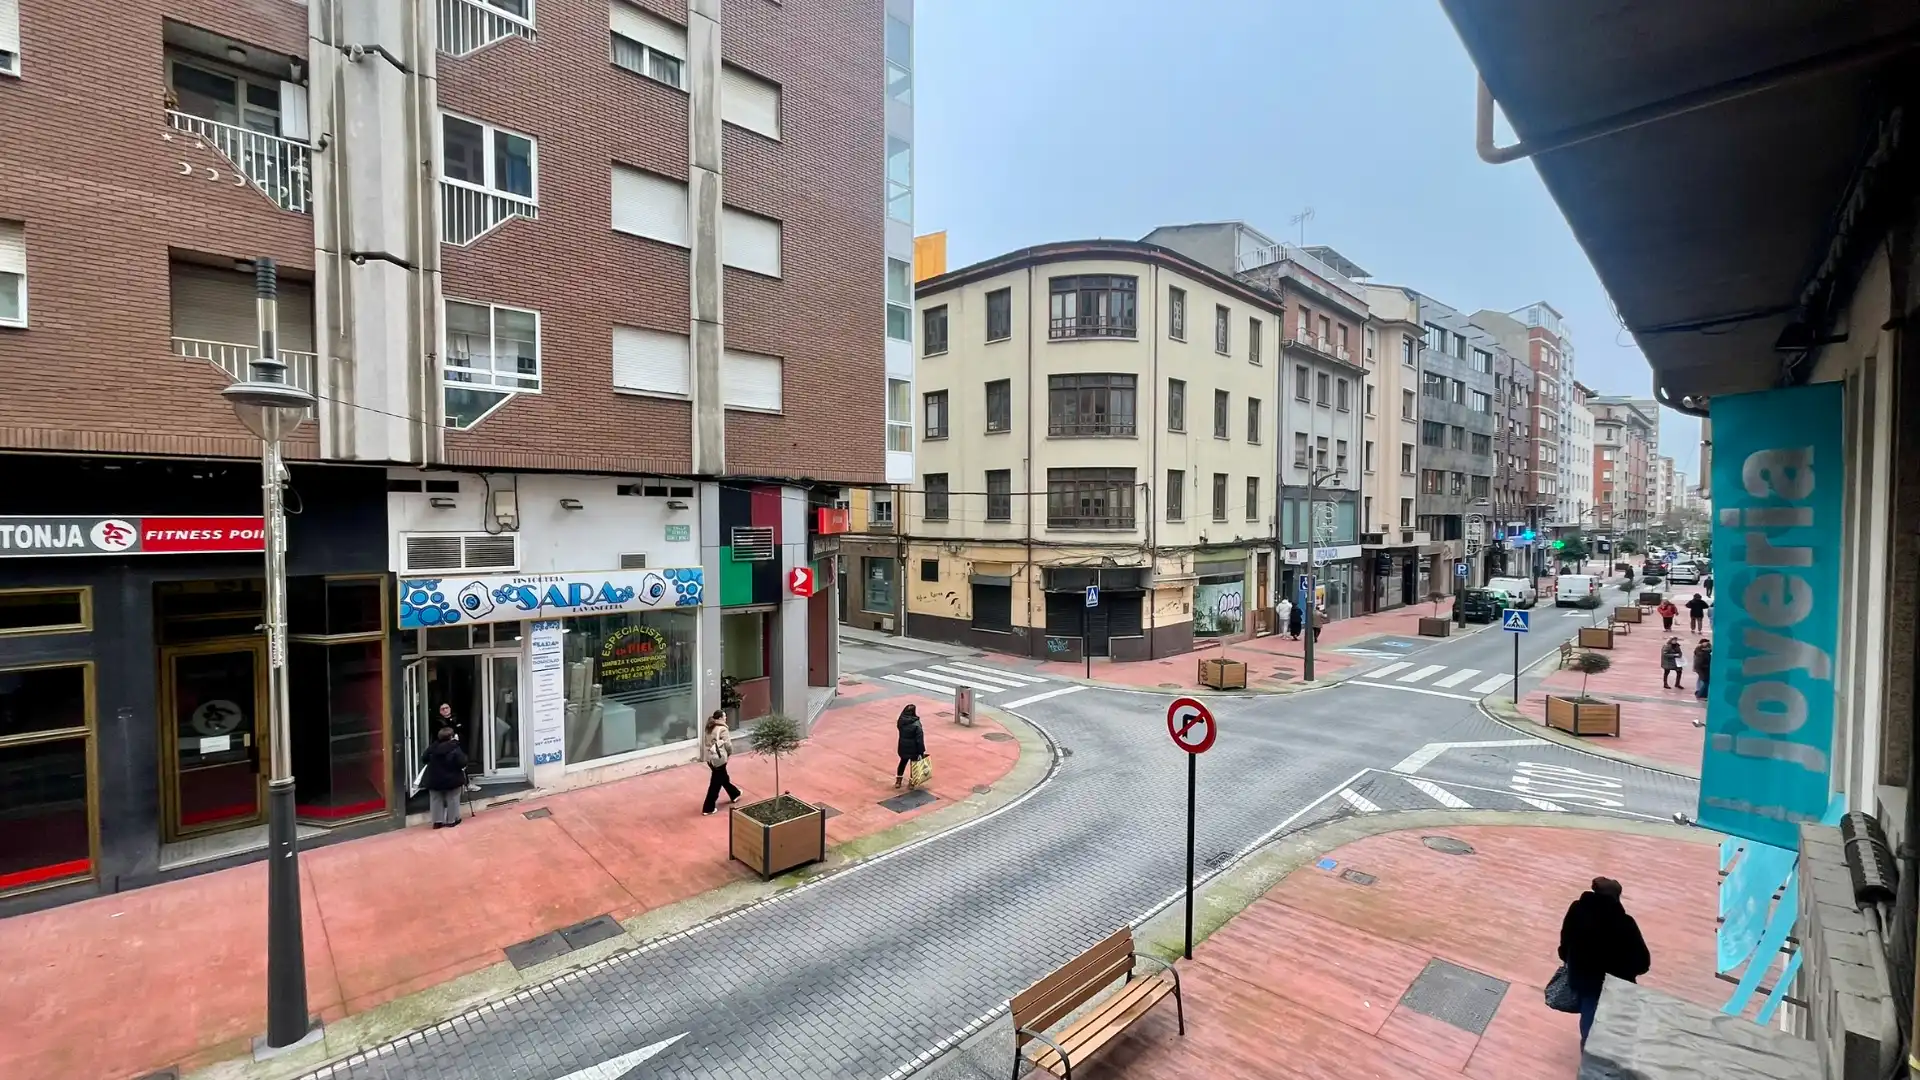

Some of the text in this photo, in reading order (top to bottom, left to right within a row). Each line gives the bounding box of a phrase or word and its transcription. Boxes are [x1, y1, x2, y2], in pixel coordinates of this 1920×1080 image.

[145, 529, 265, 541] FITNESS POI
[515, 581, 624, 610] SARA
[1712, 446, 1832, 775] joyeria
[601, 624, 667, 657] ESPECIALISTAS
[601, 667, 629, 677] SERVICIO
